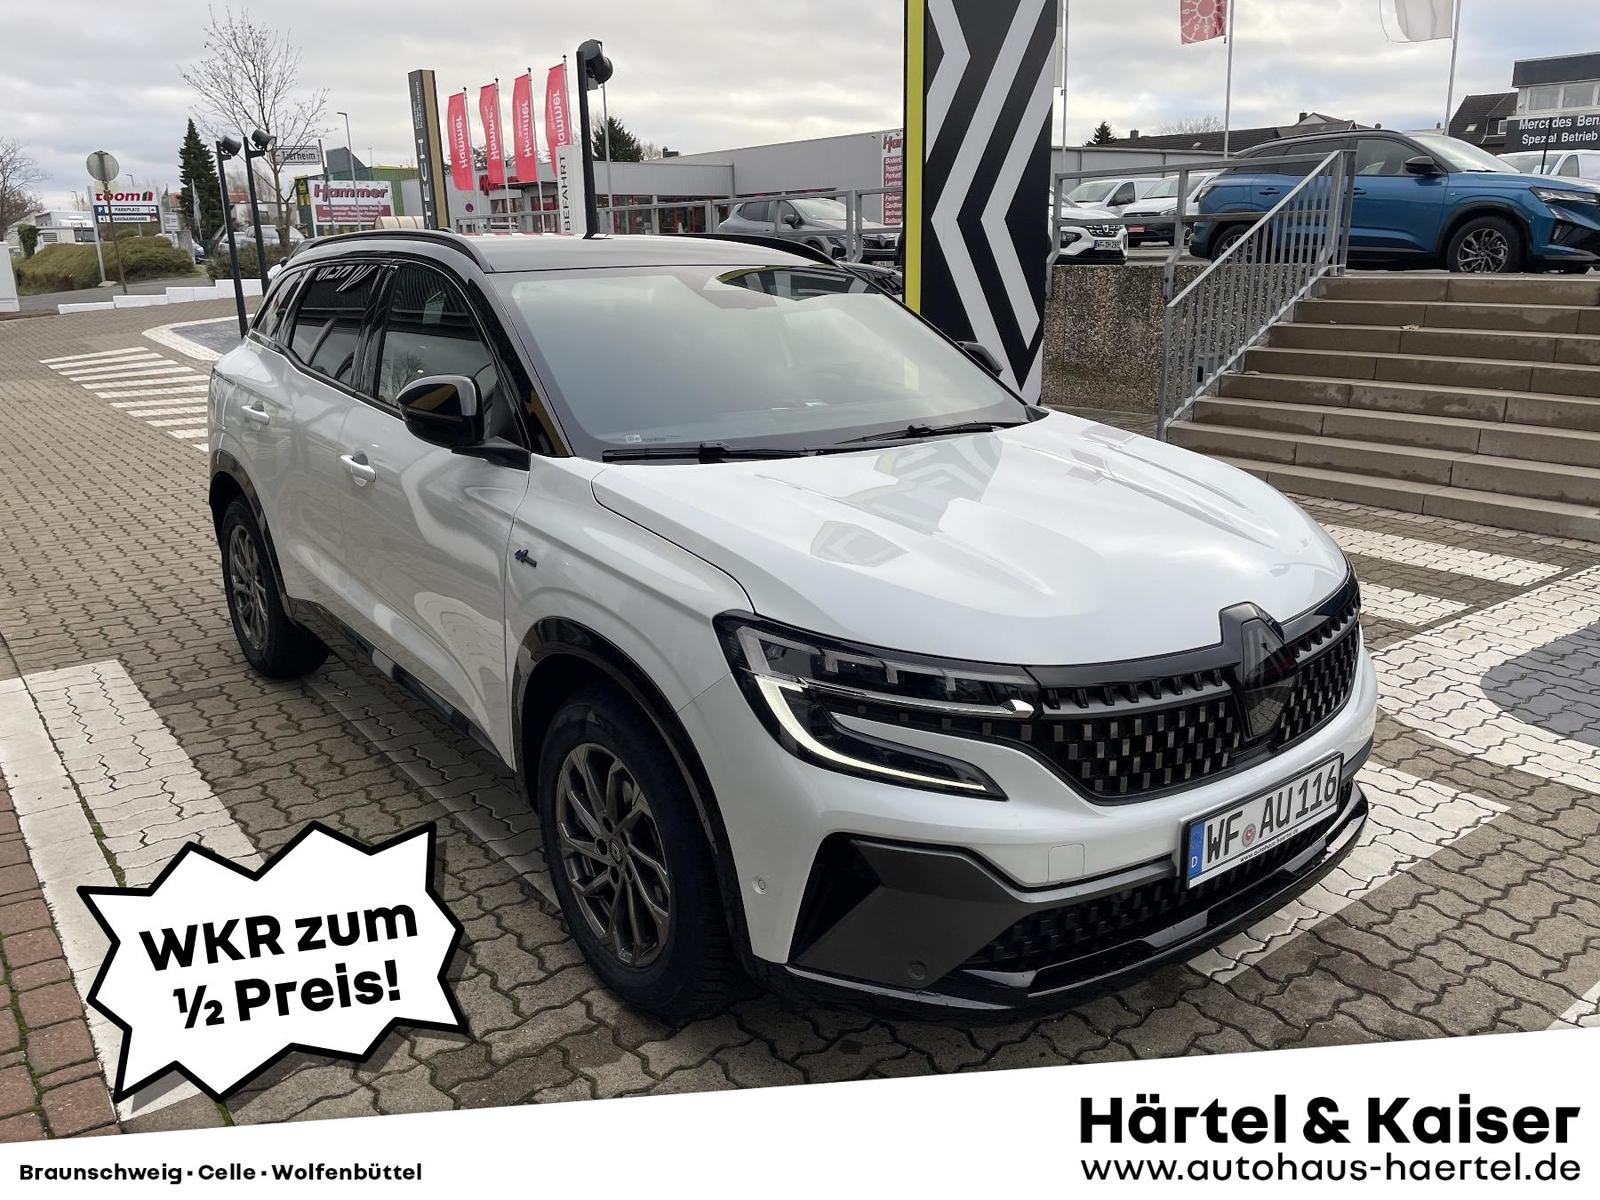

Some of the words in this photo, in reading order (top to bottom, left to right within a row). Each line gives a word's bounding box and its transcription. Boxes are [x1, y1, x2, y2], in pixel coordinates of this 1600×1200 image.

[521, 101, 532, 158] Hammer
[1521, 132, 1557, 146] Spezal
[1561, 130, 1598, 142] Betrieb
[1577, 115, 1600, 127] Ben
[455, 115, 468, 168] Hammer
[314, 184, 389, 202] Hammer
[1191, 856, 1198, 869] D
[1207, 810, 1244, 864] WF
[1259, 786, 1294, 839] AU
[1295, 764, 1337, 820] 116
